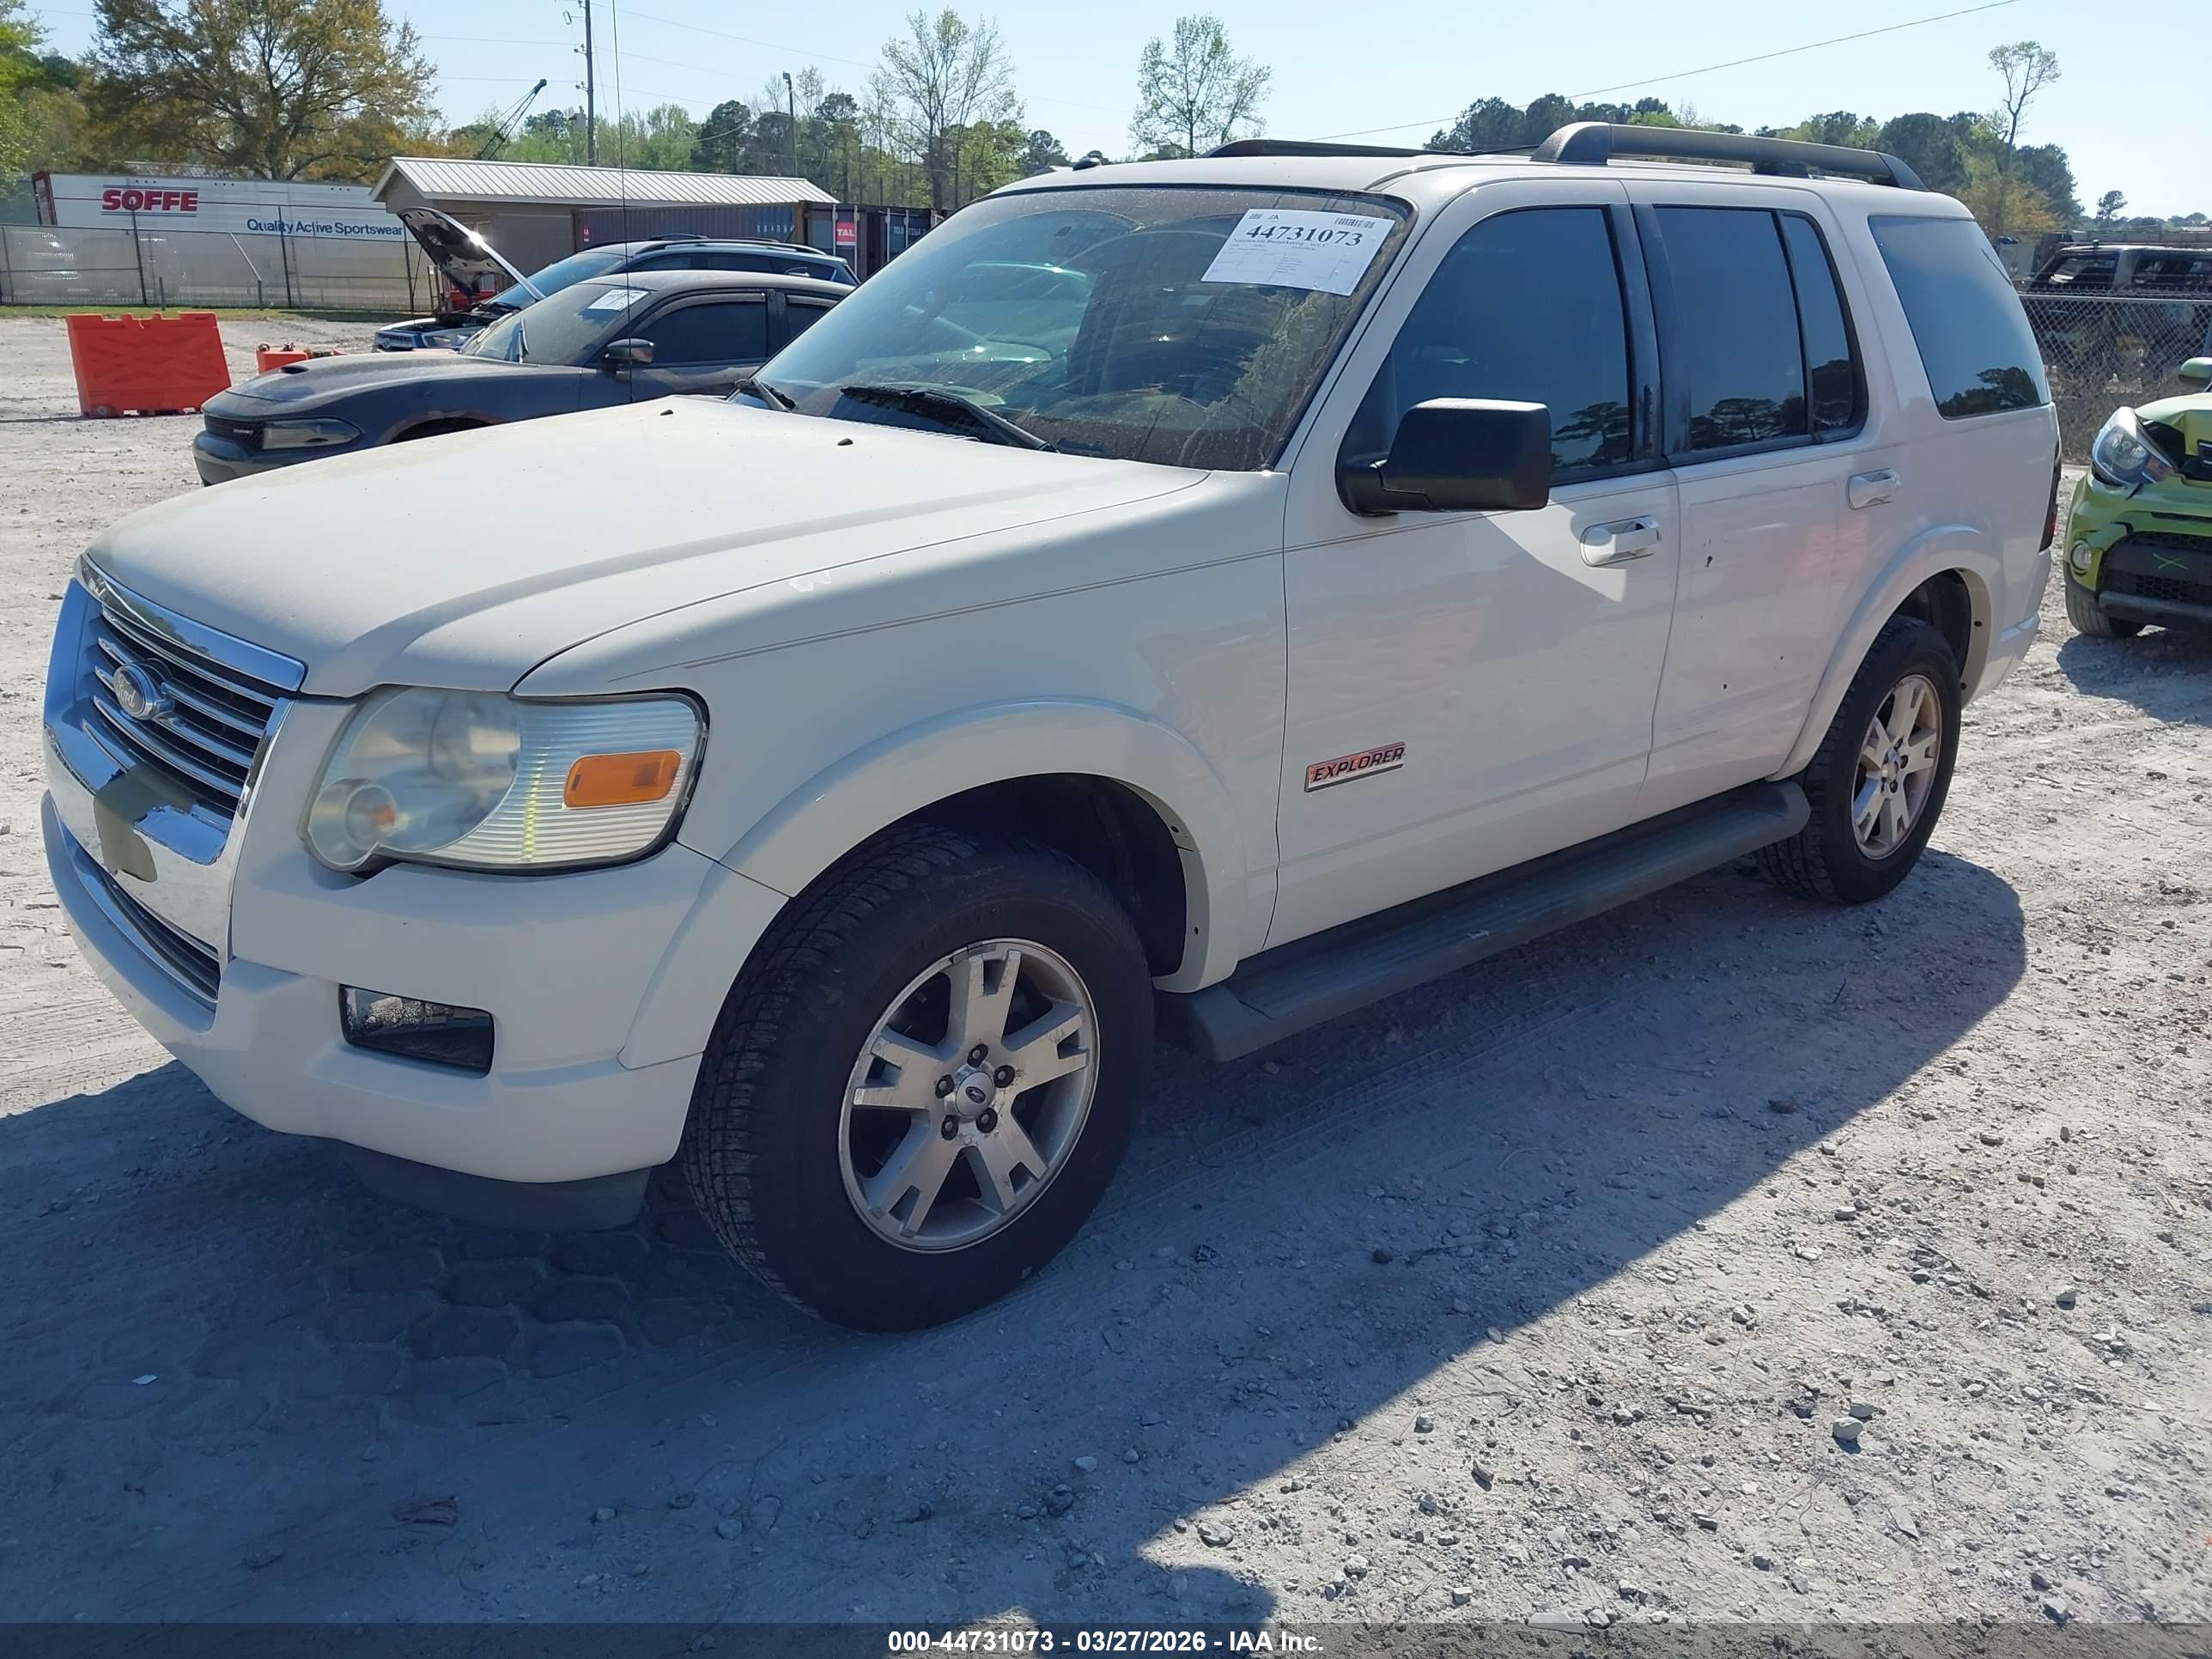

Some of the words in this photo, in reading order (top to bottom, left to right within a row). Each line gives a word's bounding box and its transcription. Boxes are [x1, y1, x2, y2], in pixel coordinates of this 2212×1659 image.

[101, 190, 198, 211] SOFFE
[247, 218, 294, 234] Quality
[295, 221, 332, 234] Active
[335, 222, 403, 236] Sportswear
[1246, 224, 1364, 246] 44731073
[116, 673, 137, 708] Ford
[1312, 746, 1405, 782] EXPLORER
